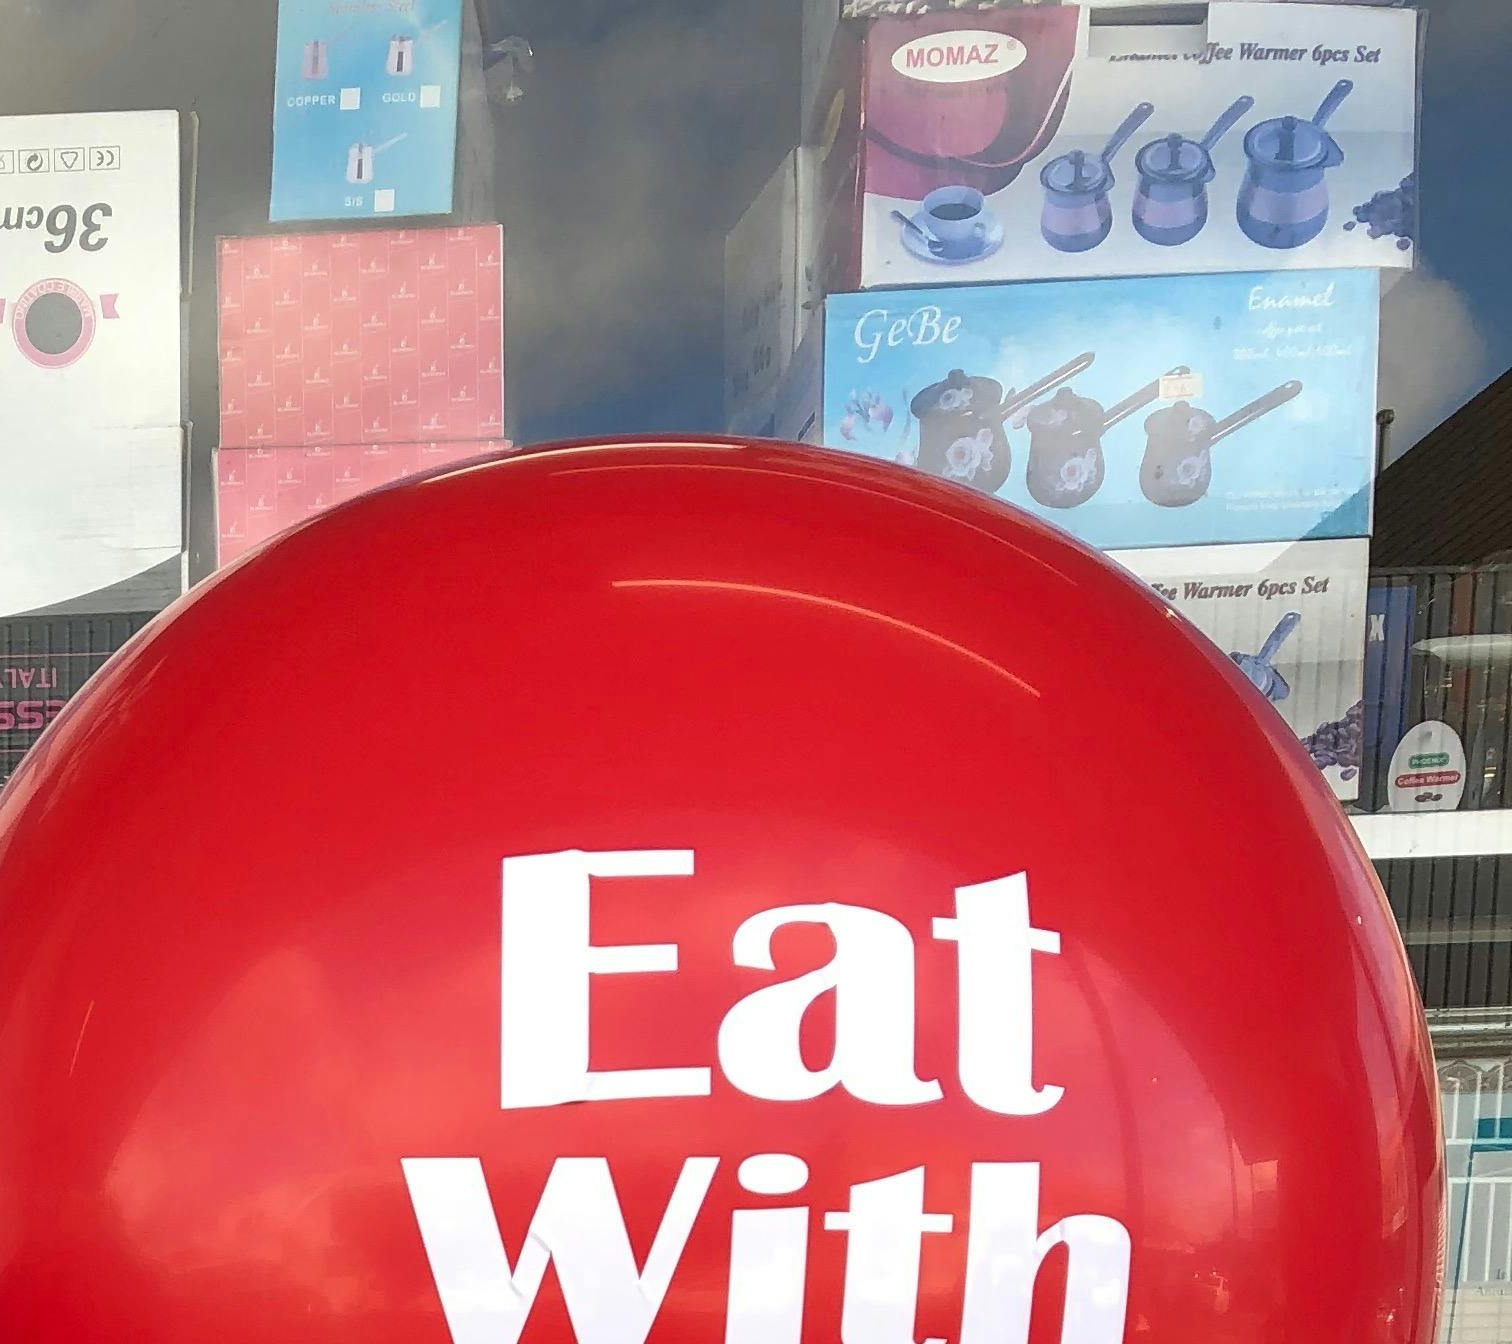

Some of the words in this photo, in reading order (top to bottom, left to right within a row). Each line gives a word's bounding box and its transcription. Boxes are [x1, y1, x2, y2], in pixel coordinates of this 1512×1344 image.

[906, 44, 998, 68] MOMAZ
[1238, 44, 1307, 64] Warmer
[1311, 44, 1348, 66] 6pcs
[1354, 45, 1380, 63] Set
[288, 94, 336, 107] COPPER
[382, 92, 416, 103] GOLD
[1247, 282, 1336, 312] Enamel
[854, 305, 963, 363] GeBe
[1184, 580, 1253, 600] Warmer
[1258, 577, 1297, 599] 6pcs
[1301, 575, 1330, 595] Set
[501, 849, 1065, 1116] Eat
